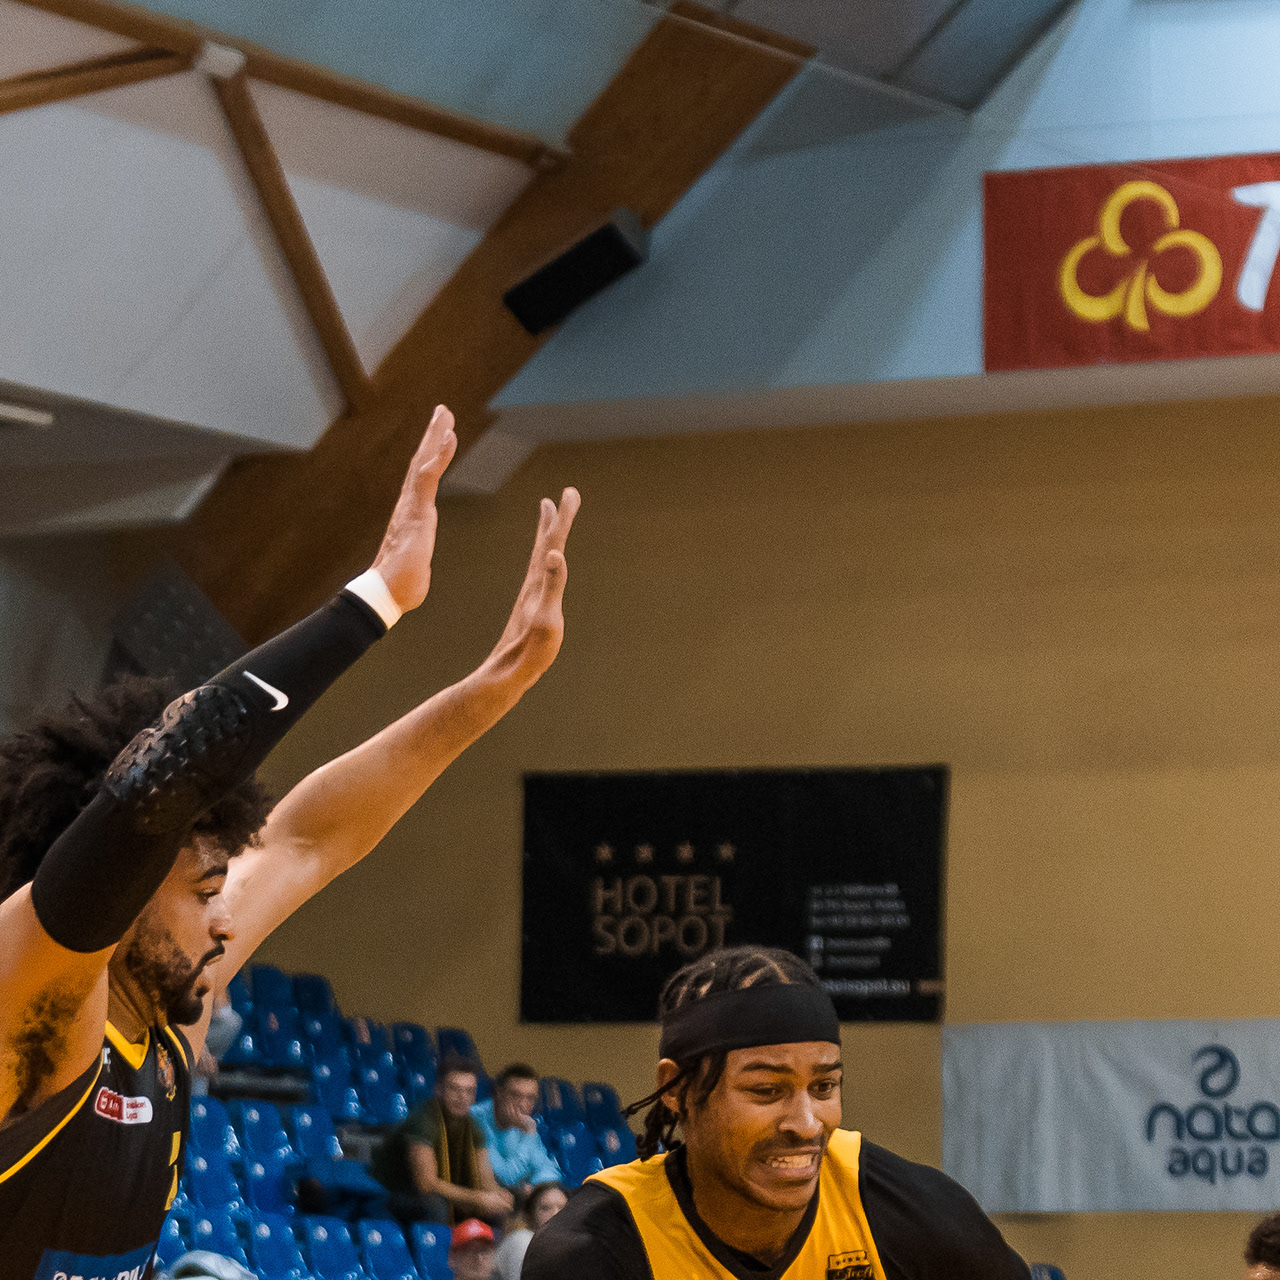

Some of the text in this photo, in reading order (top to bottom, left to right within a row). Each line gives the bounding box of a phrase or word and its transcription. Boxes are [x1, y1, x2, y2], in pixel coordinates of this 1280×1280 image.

[594, 875, 732, 916] HOTEL
[594, 915, 732, 955] SOPOT
[1168, 1146, 1269, 1185] aqua
